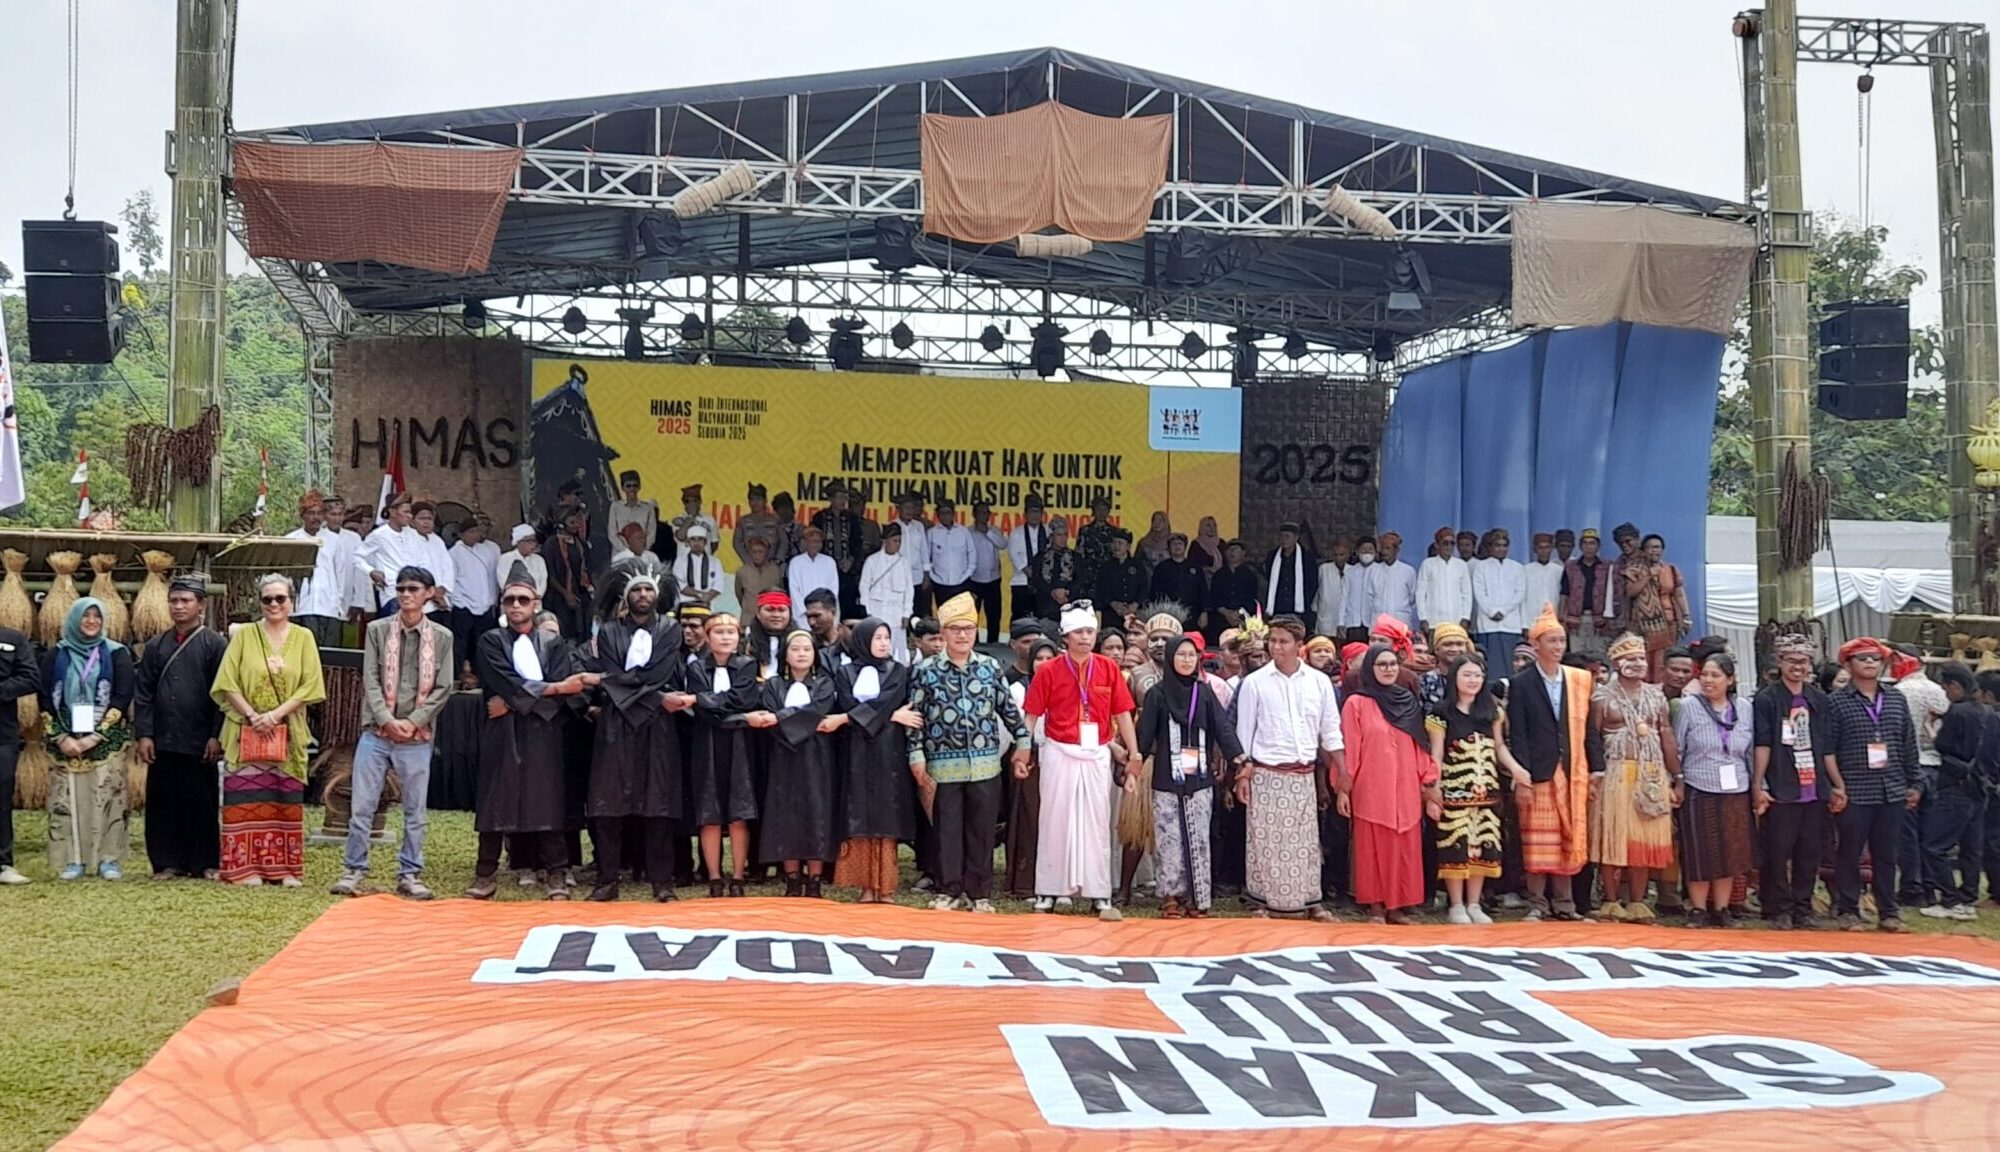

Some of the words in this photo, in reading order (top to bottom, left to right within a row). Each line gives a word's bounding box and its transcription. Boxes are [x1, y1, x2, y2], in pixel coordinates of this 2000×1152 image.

[650, 399, 692, 417] HIMAS
[657, 418, 692, 435] 2025
[351, 415, 519, 470] HIMAS
[728, 426, 747, 440] 2025
[841, 442, 994, 476] MEMPERKUAT
[1002, 449, 1045, 478] HAK
[1053, 453, 1123, 480] UNTUK
[1254, 443, 1371, 484] 2025
[955, 477, 1020, 507] NASIB
[516, 930, 935, 980] ADAT
[1181, 989, 1571, 1044] RUU
[1046, 1035, 1895, 1118] SAHKAN
